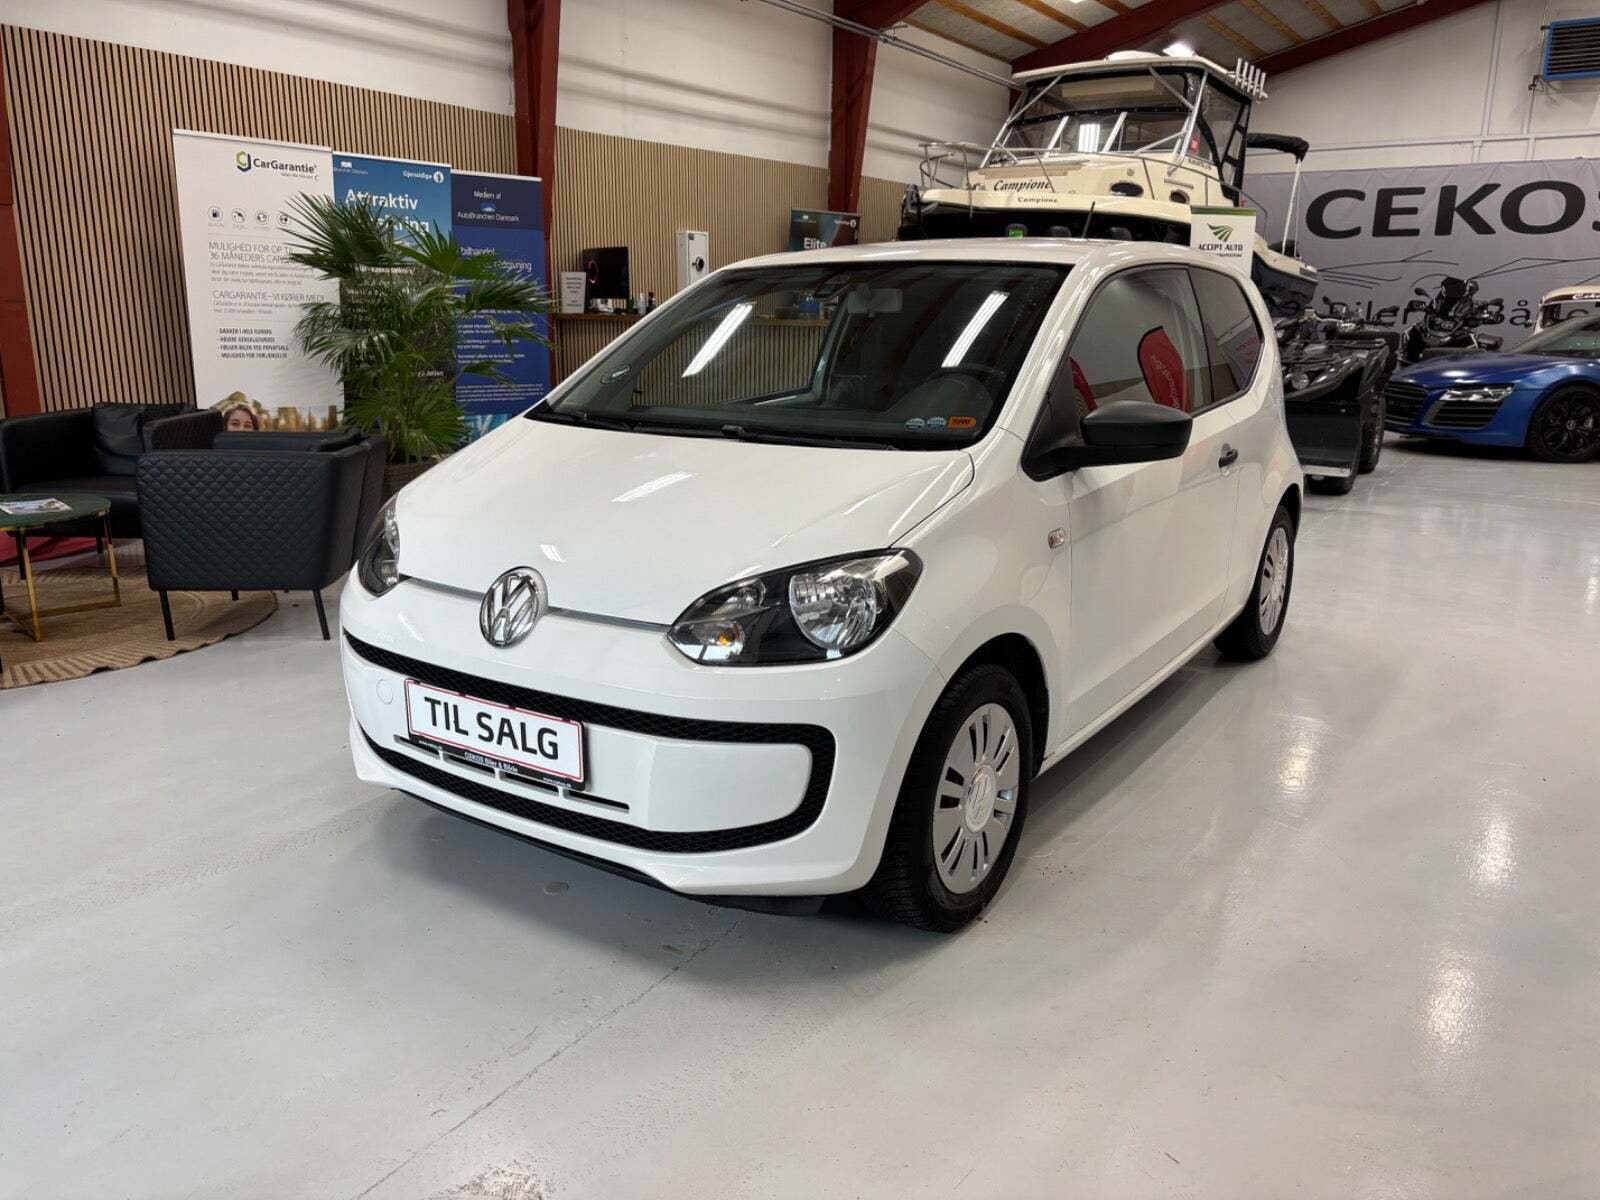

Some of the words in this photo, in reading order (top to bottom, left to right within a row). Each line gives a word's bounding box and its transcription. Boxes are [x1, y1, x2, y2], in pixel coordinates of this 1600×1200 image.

[253, 158, 315, 174] CarGarantie
[346, 189, 418, 210] Attraktiv
[1305, 180, 1600, 239] CEKO
[803, 237, 827, 249] Elite
[424, 696, 469, 737] TIL
[476, 711, 558, 760] SALG
